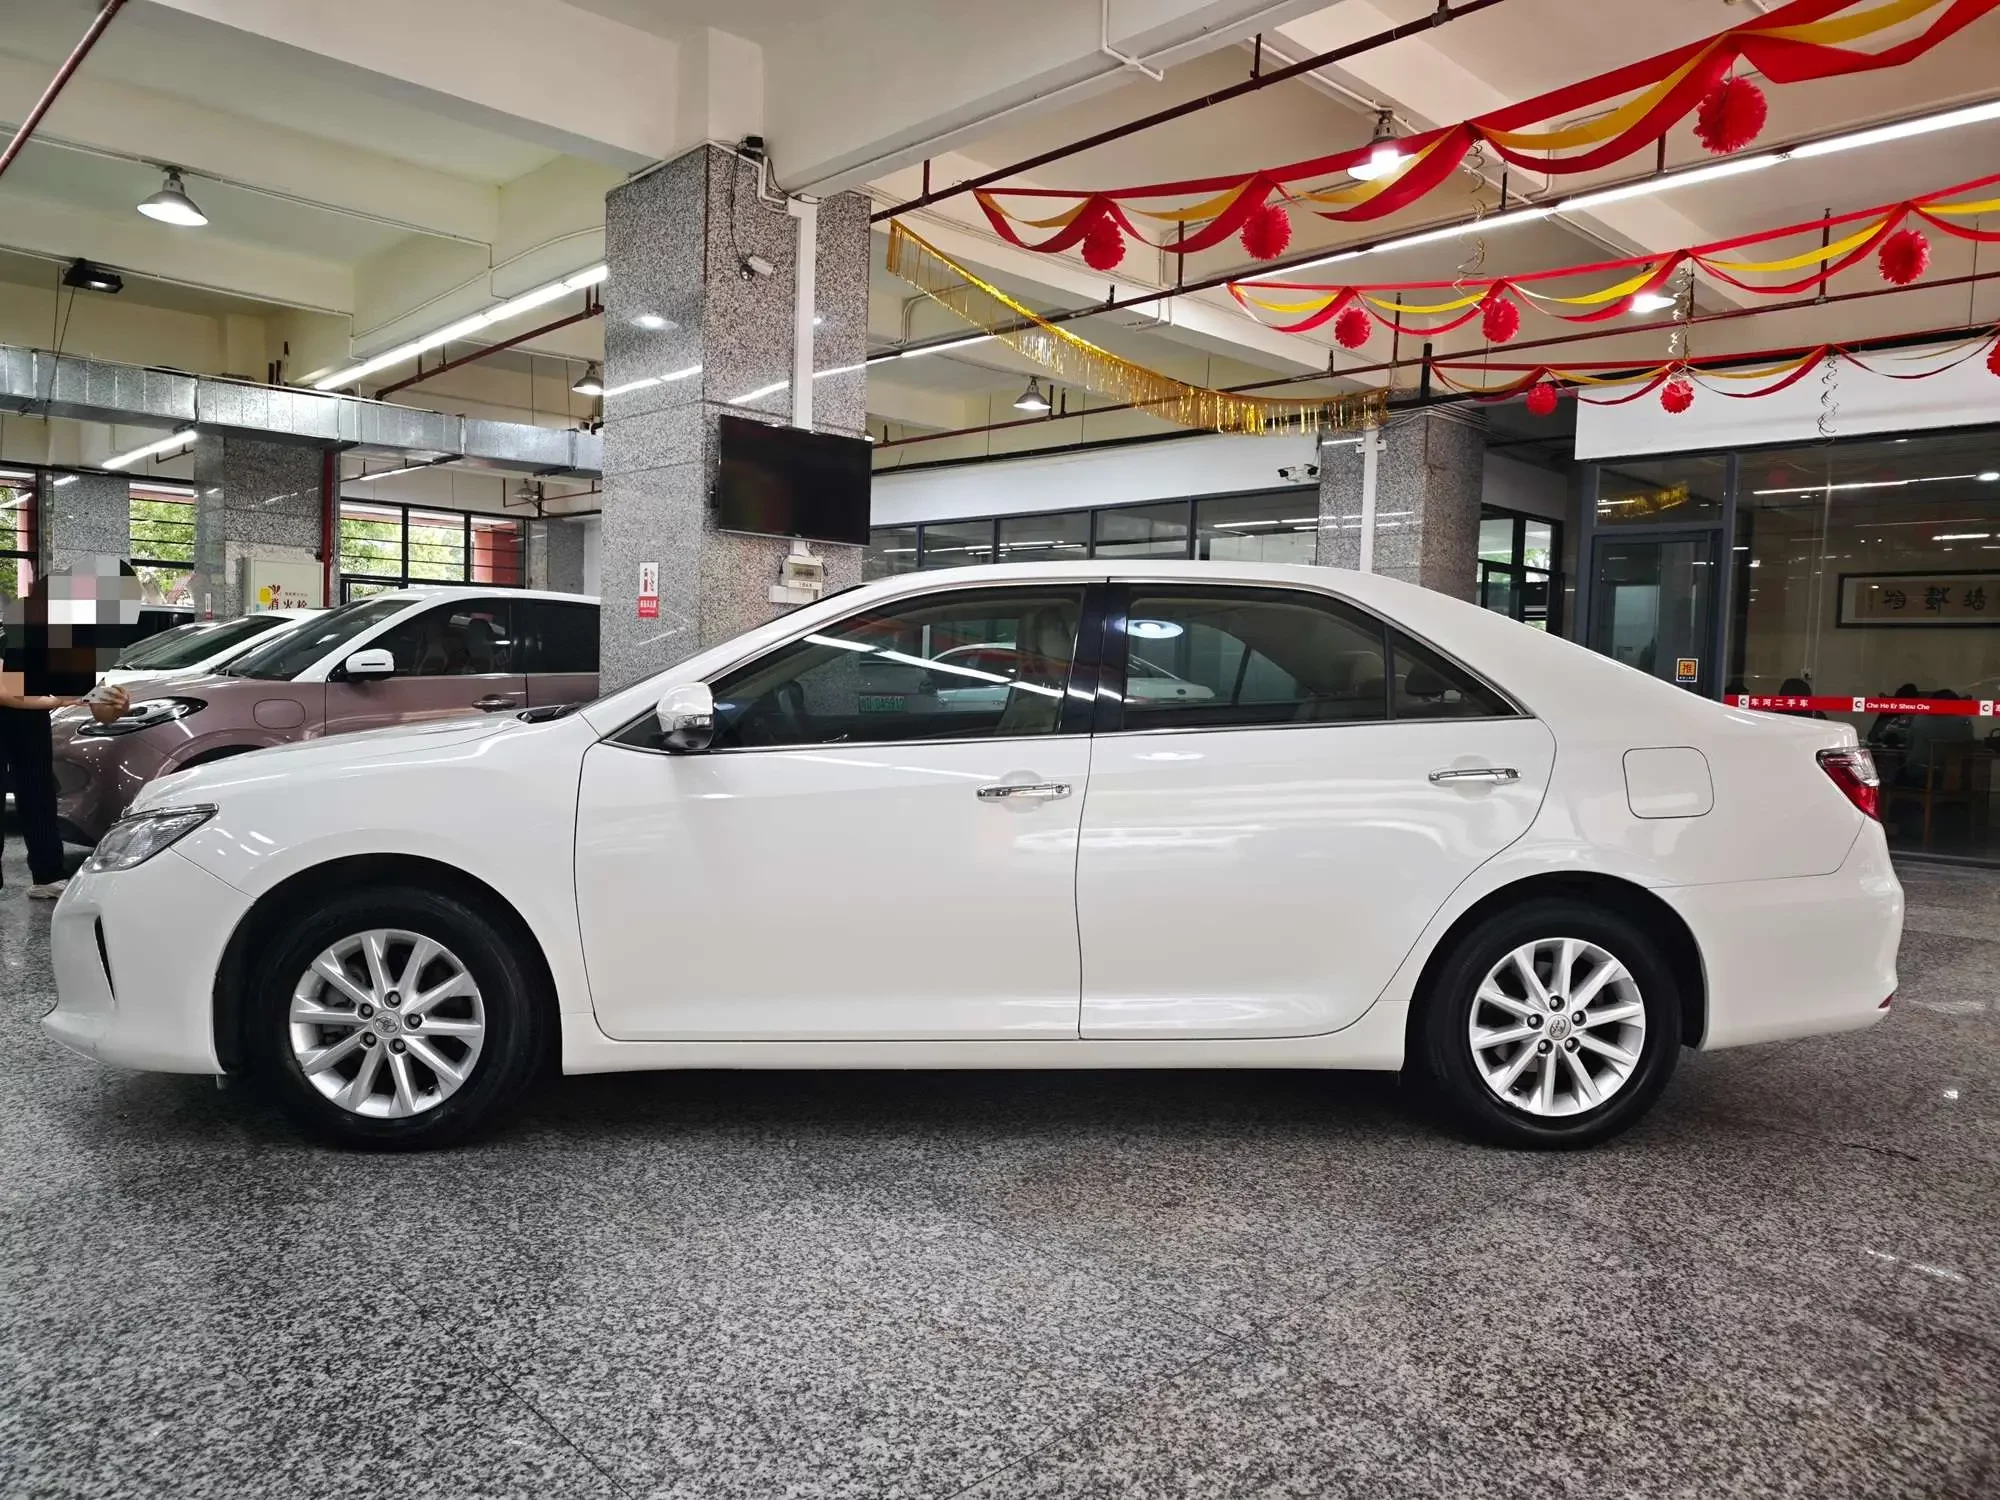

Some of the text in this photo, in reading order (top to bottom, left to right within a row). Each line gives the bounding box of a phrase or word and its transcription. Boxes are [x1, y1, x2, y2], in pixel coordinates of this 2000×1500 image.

[1682, 662, 1694, 674] 推
[1750, 698, 1809, 708] 车河二手车
[1917, 703, 1930, 711] Che
